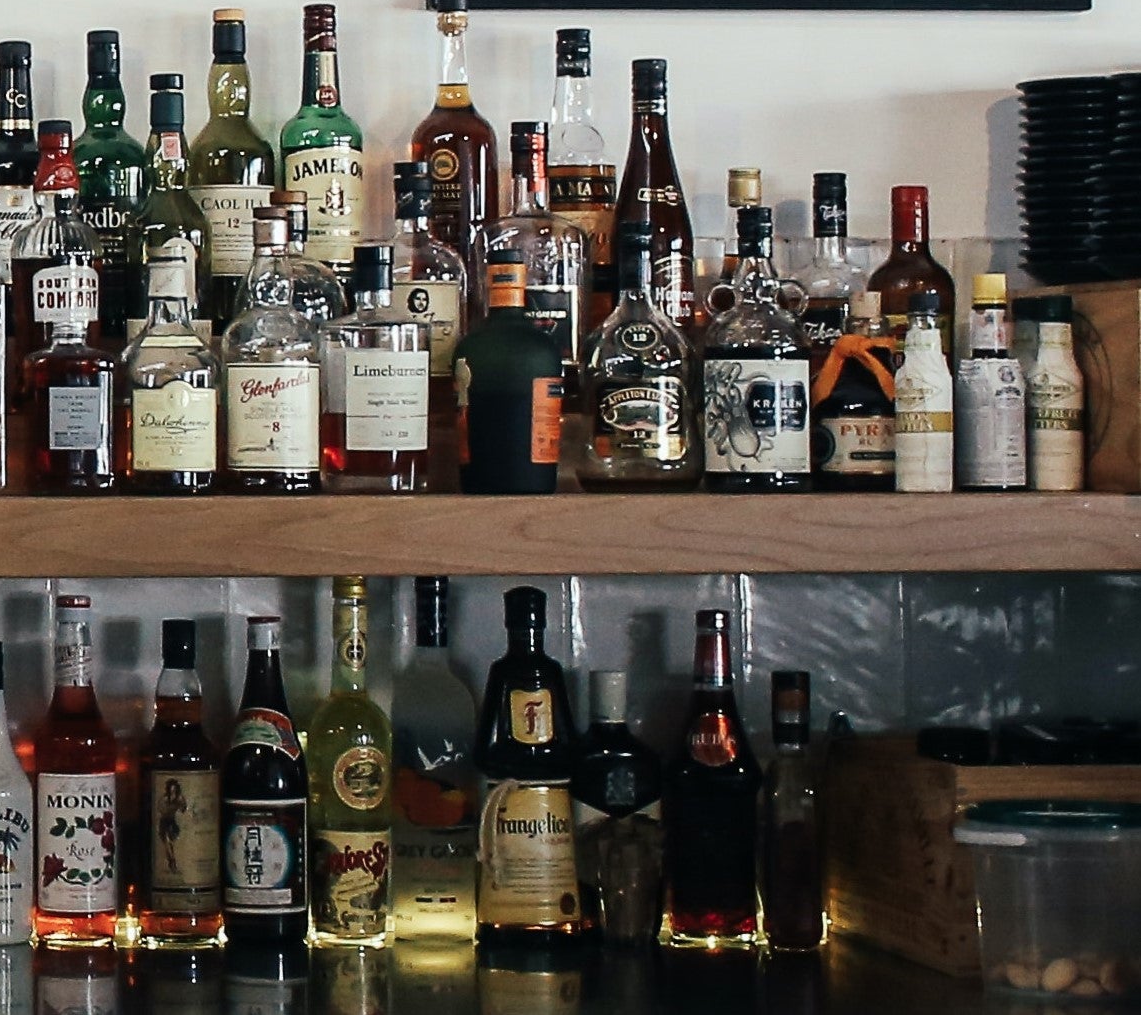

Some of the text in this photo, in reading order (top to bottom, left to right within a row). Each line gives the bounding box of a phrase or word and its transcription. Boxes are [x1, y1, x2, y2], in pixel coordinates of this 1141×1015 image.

[200, 197, 241, 211] CAOL
[225, 217, 241, 230] 12
[271, 421, 281, 433] 8
[46, 793, 113, 810] MONIN
